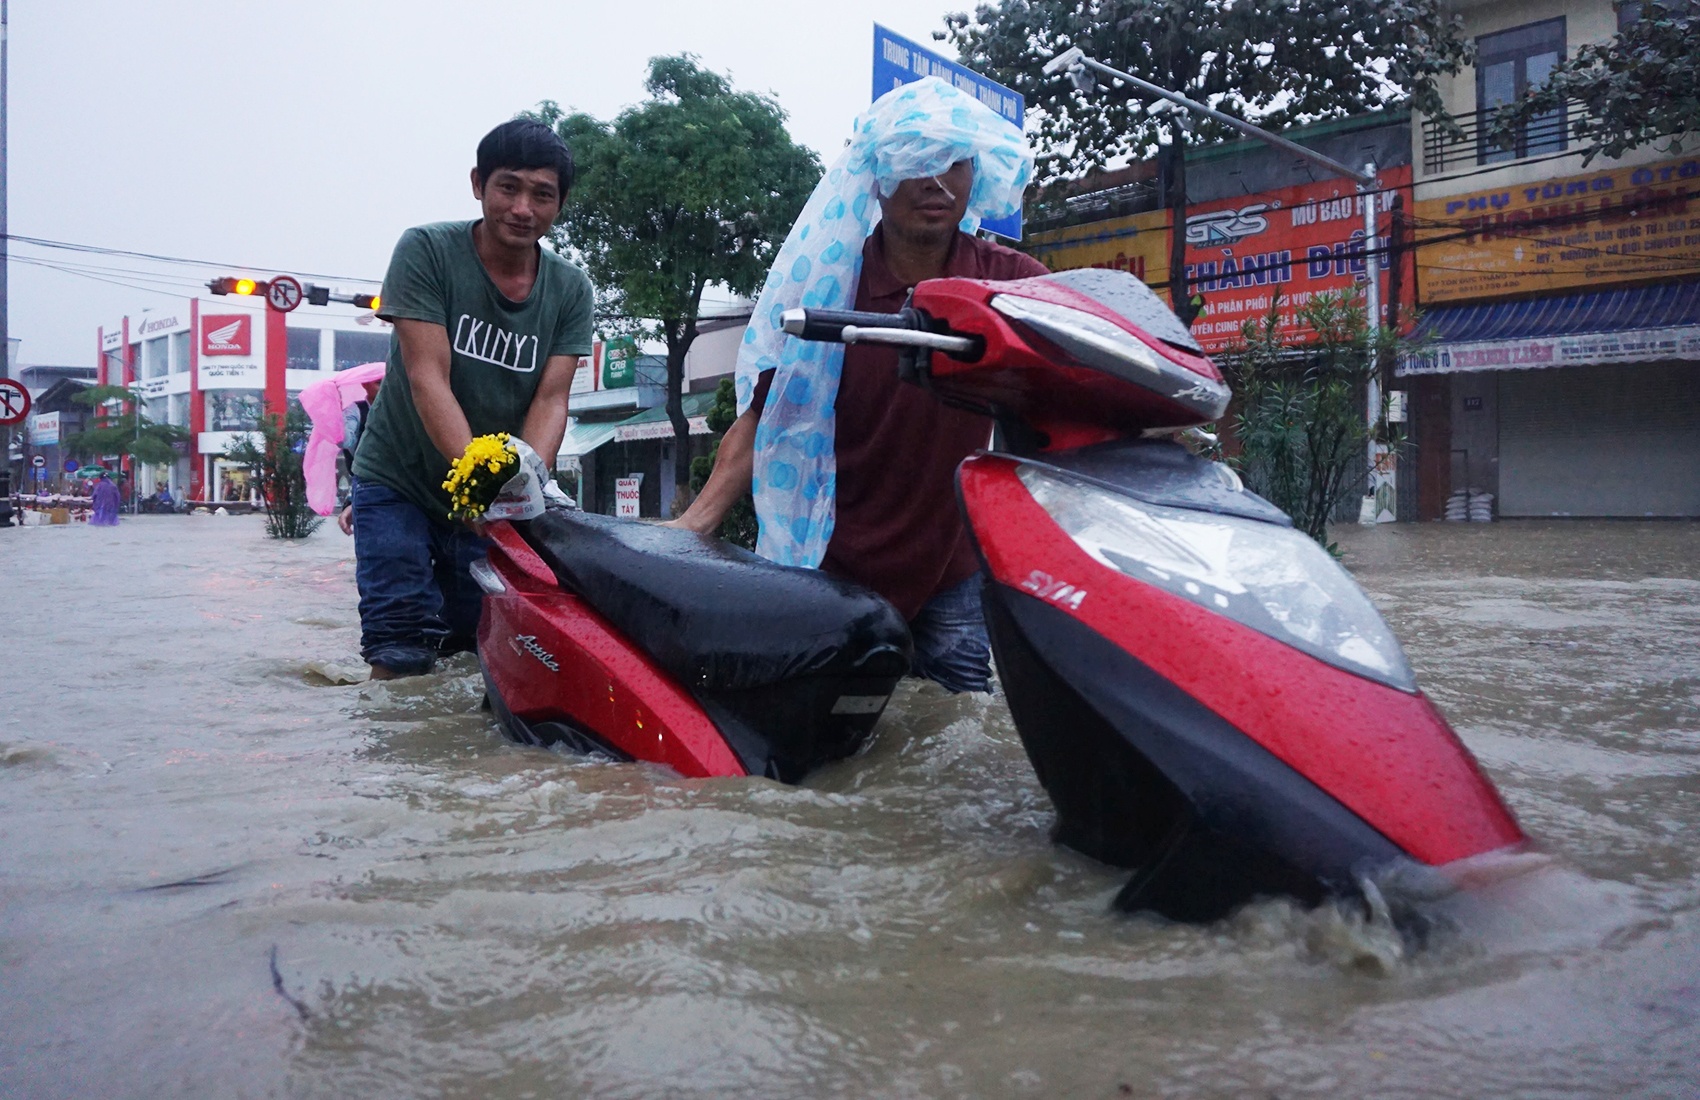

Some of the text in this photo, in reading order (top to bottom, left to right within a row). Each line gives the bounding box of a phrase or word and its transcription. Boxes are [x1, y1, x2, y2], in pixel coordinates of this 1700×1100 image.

[883, 38, 909, 70] TRUNG
[913, 52, 930, 77] TÂM
[979, 85, 1002, 113] THÀNH
[1003, 95, 1017, 120] PHỐ
[1292, 182, 1395, 227] MŨ BẢO HM
[1186, 203, 1267, 243] GRS
[1184, 249, 1292, 295] THÀNH
[1202, 300, 1216, 316] HÀ
[1218, 298, 1244, 314] PHÂN
[1246, 293, 1268, 311] PHỐI
[147, 316, 179, 333] HONDA
[1216, 319, 1239, 333] CUNG
[610, 360, 627, 371] CRB
[616, 488, 640, 500] THUỐC
[621, 503, 635, 513] TÂY
[1021, 569, 1087, 610] SYM
[515, 633, 560, 672] Attila
